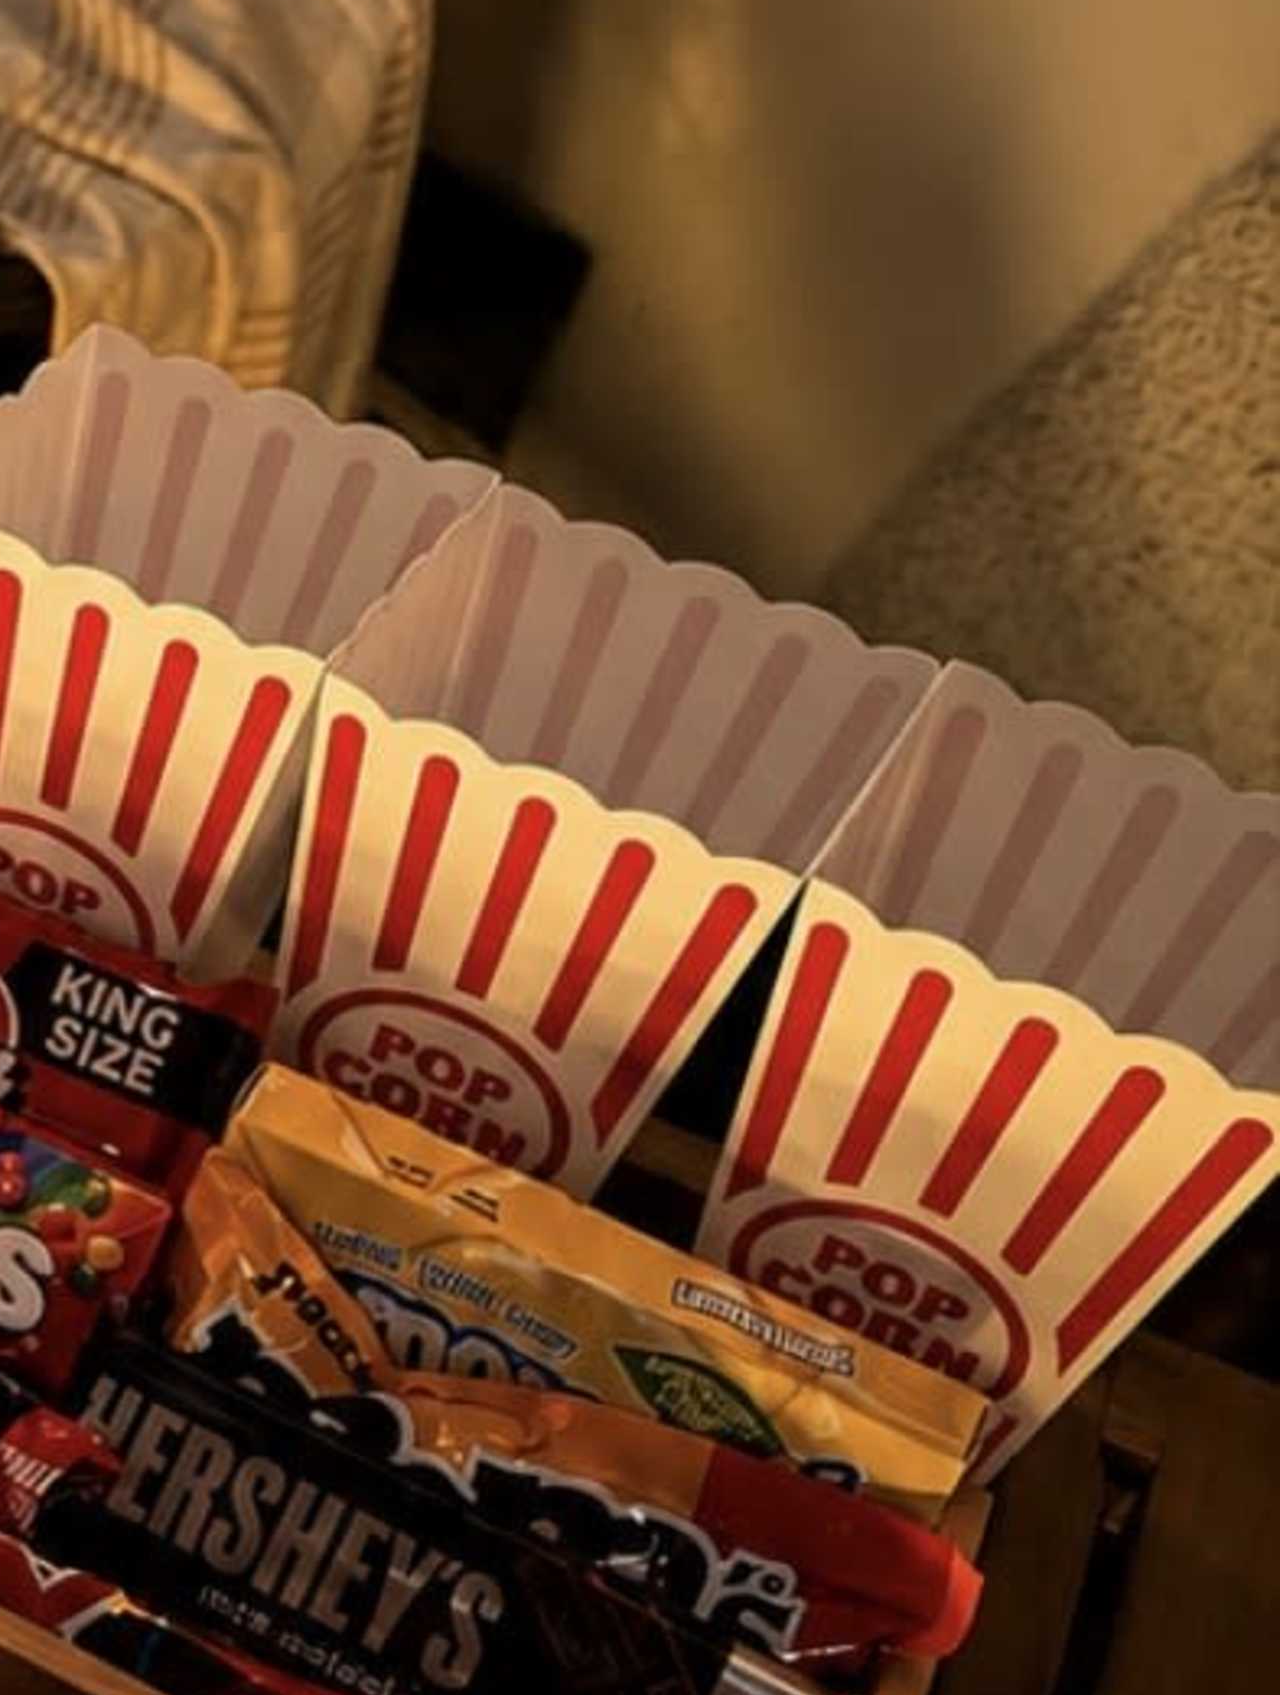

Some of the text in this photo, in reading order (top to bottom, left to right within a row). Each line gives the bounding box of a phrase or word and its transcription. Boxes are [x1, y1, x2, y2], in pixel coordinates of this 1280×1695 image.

[49, 962, 181, 1051] KING
[44, 1016, 165, 1095] SIZE
[368, 1023, 512, 1105] POP
[323, 1050, 527, 1168] CORN
[760, 1258, 981, 1383] CORN
[812, 1234, 971, 1324] POP
[76, 1372, 507, 1692] HERSHEY'S
